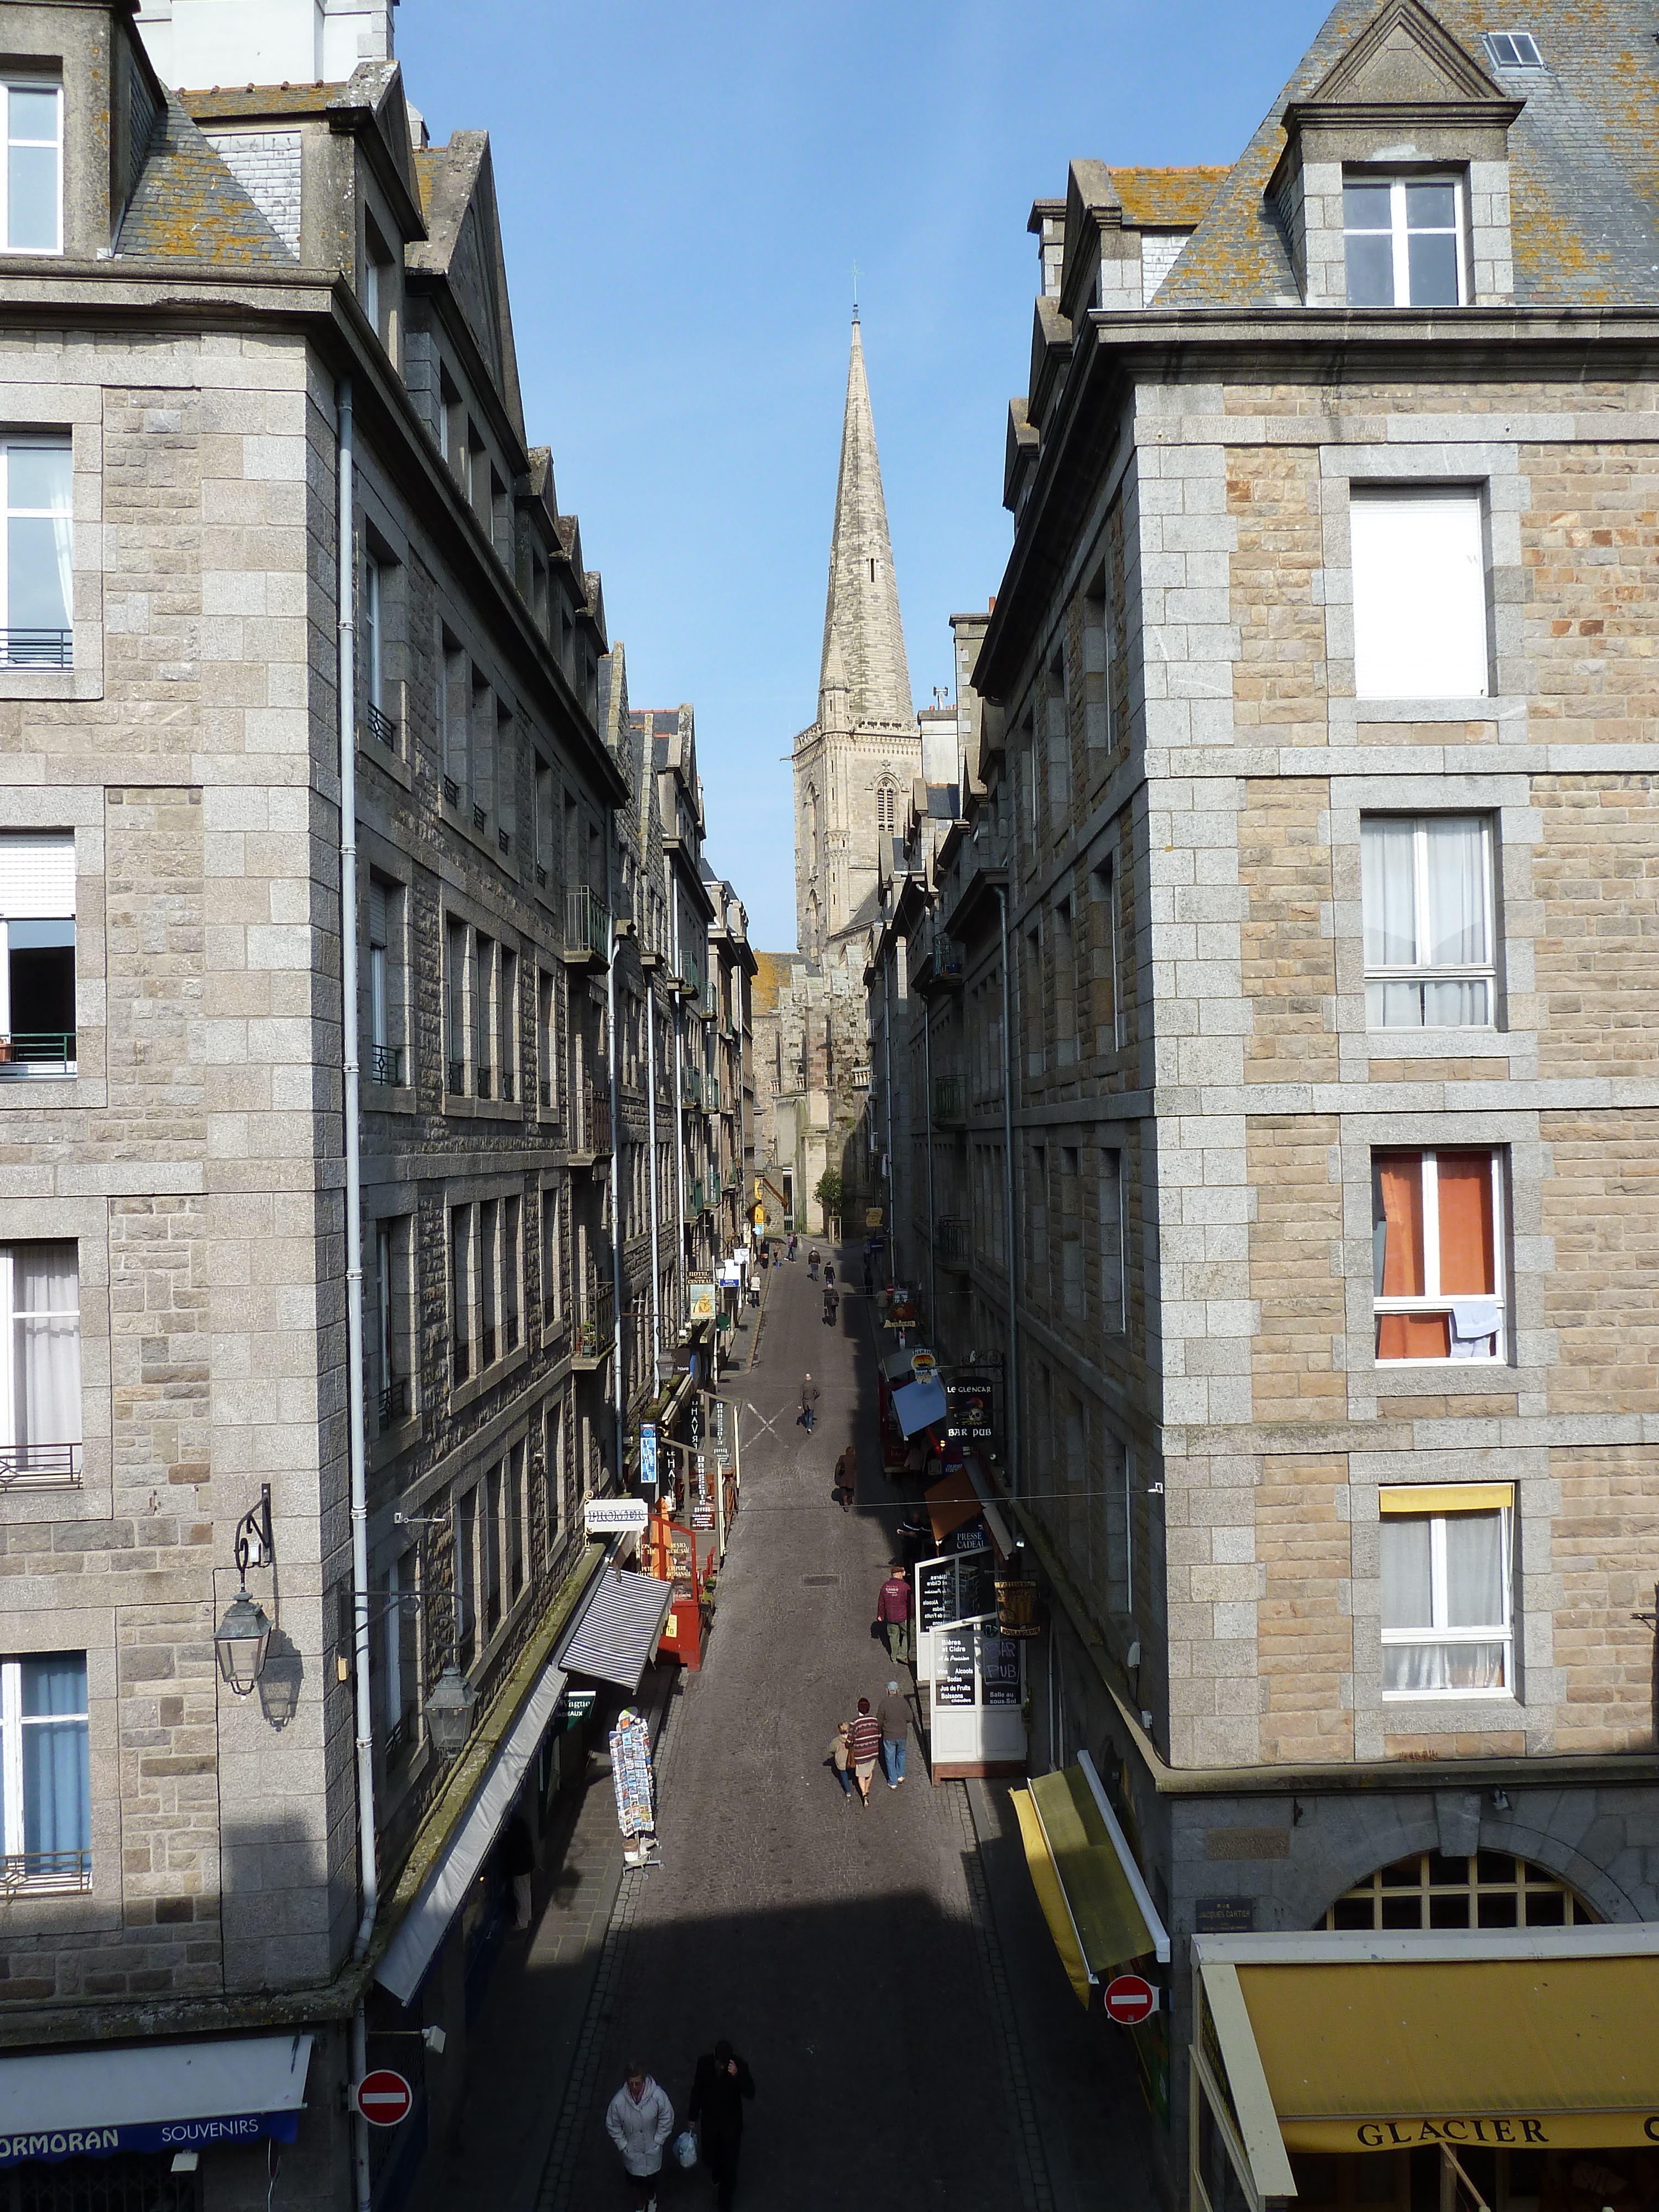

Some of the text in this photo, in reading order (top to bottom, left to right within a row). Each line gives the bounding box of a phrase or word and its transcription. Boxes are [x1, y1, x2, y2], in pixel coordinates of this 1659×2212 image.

[948, 1428, 992, 1438] BAR PUB
[697, 1456, 706, 1505] BRASSERIE
[589, 1510, 645, 1522] PROMER
[957, 1532, 982, 1541] PRESSE
[986, 1641, 1016, 1659] BAR
[987, 1663, 1017, 1678] PUB
[1199, 1910, 1251, 1919] JACQUES CARTIER
[162, 2118, 259, 2142] SOUVENIRS
[1357, 2120, 1550, 2146] GLACIER
